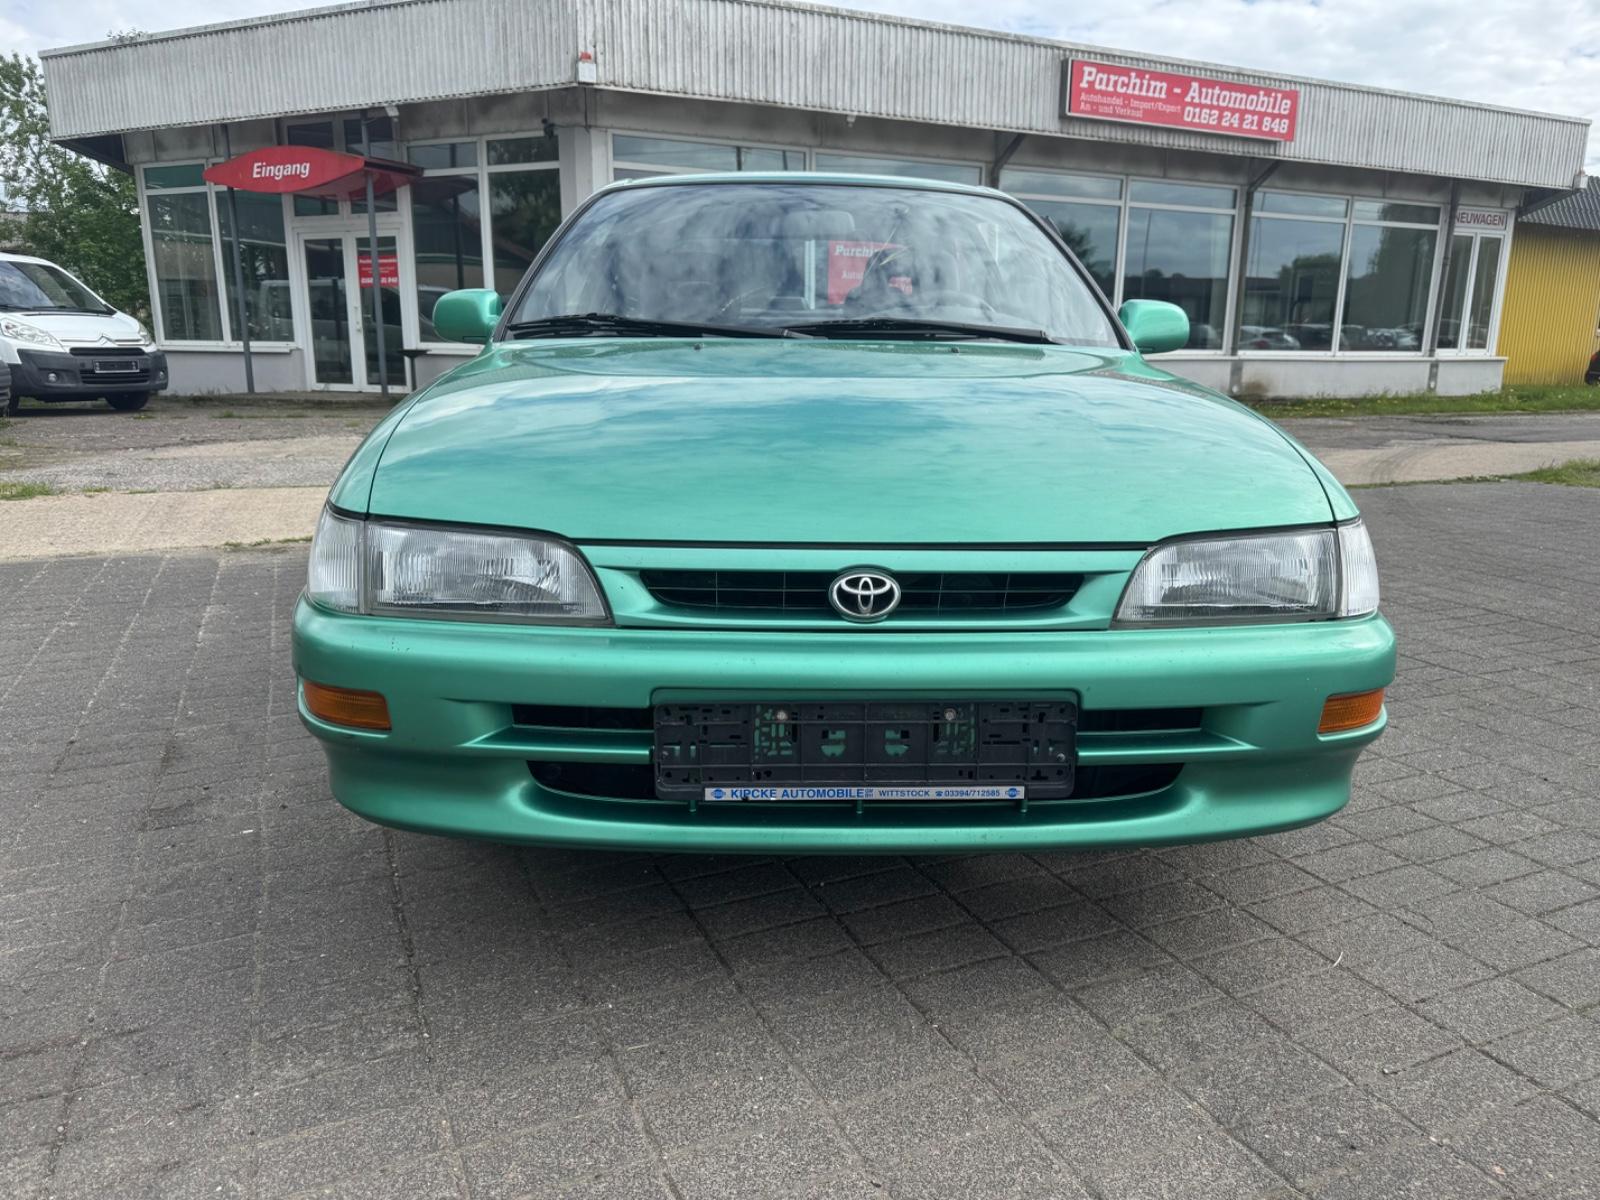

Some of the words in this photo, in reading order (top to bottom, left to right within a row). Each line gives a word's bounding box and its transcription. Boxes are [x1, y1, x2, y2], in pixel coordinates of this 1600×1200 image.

[1079, 92, 1124, 106] Autohandel
[1080, 66, 1167, 99] Parchim
[1185, 82, 1292, 115] Automobile
[1079, 102, 1091, 111] An
[1098, 104, 1113, 114] und
[1115, 106, 1143, 118] Verkauf
[1221, 111, 1240, 128] 24
[1242, 114, 1258, 130] 21
[1262, 116, 1289, 134] 848
[252, 162, 310, 180] Eingang
[781, 788, 864, 798] AUTOMOBILE
[879, 789, 930, 797] WITTSTOCK
